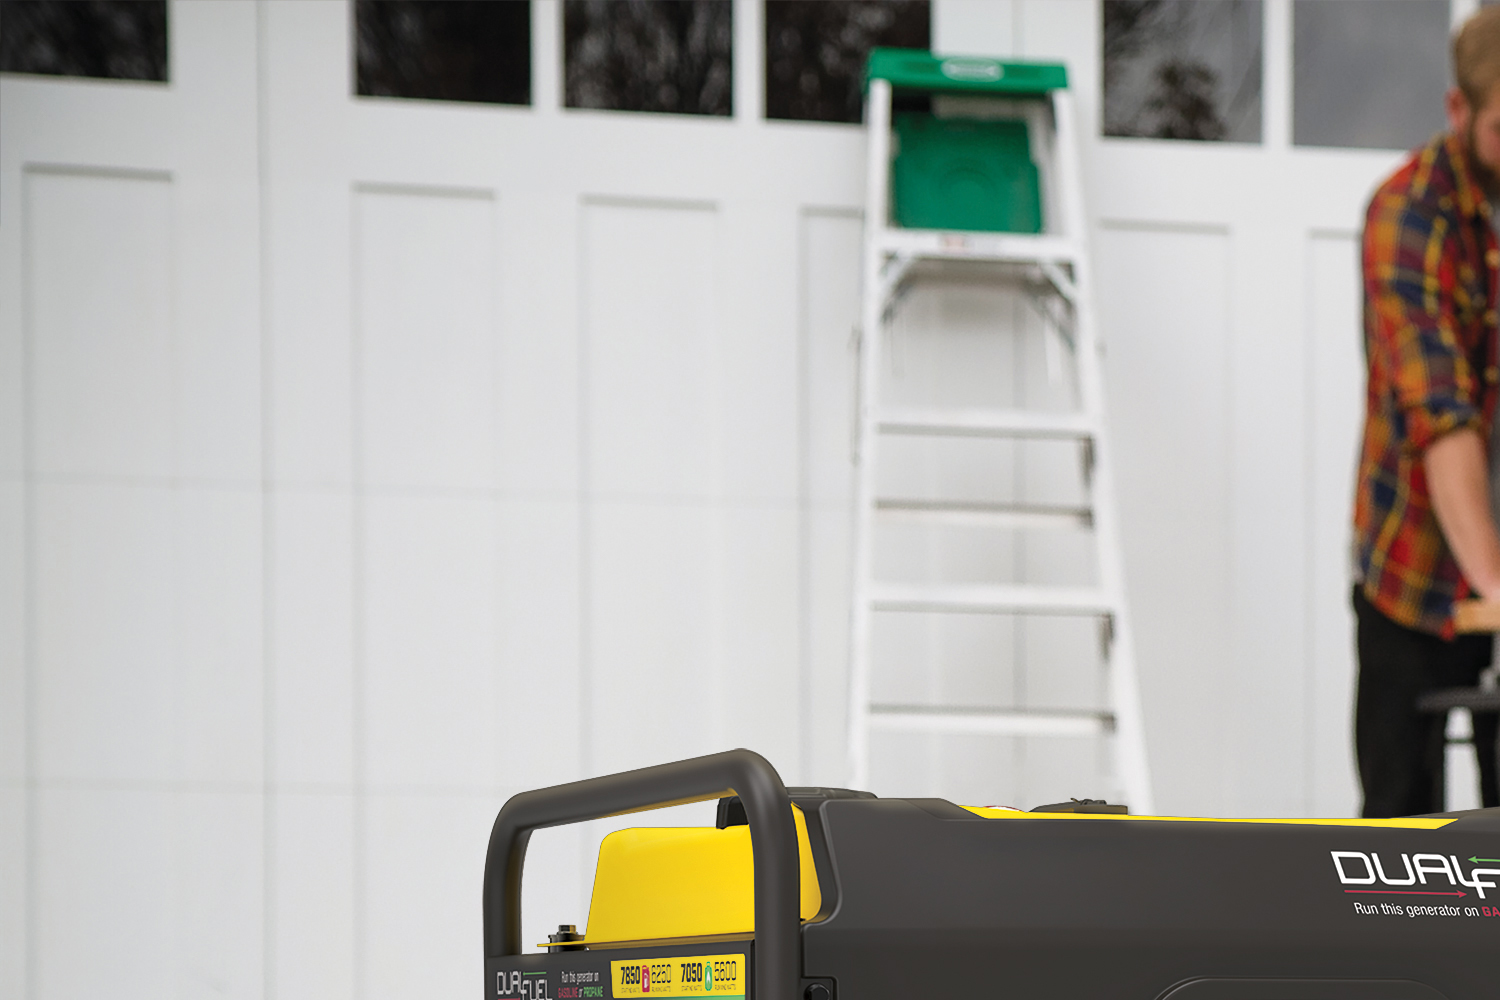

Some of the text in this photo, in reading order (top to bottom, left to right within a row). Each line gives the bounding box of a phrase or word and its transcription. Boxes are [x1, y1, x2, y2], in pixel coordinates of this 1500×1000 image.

[1353, 902, 1379, 915] Run
[1380, 903, 1404, 915] this
[1406, 904, 1460, 918] generator
[1464, 907, 1480, 917] on
[620, 961, 736, 985] 7850 6250 7050 5600
[558, 987, 578, 998] GASOLINE
[583, 986, 603, 997] PROPANE
